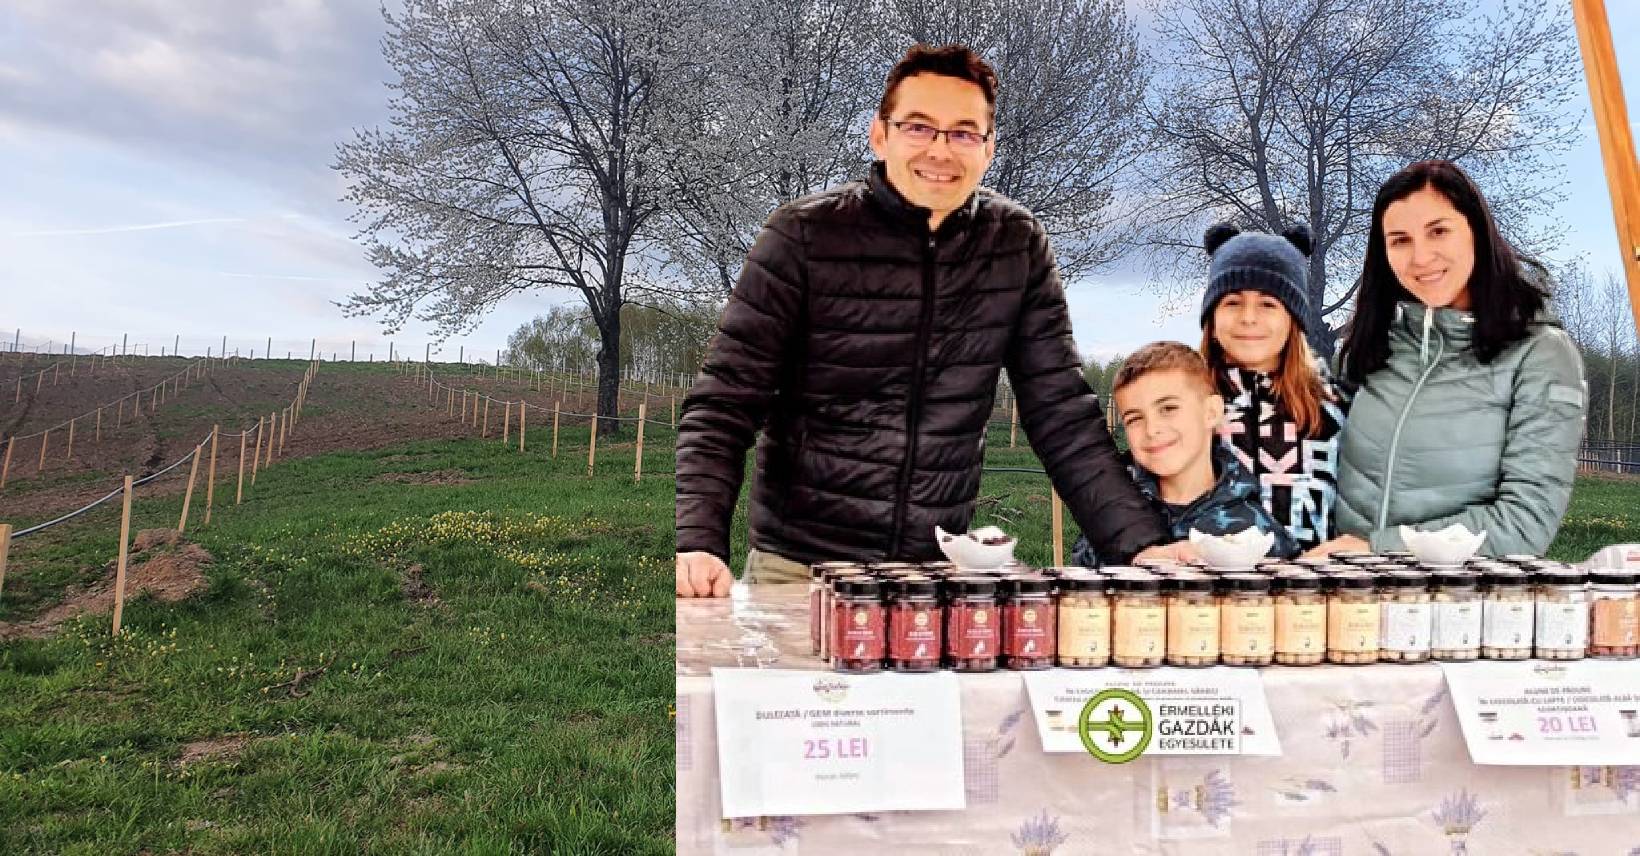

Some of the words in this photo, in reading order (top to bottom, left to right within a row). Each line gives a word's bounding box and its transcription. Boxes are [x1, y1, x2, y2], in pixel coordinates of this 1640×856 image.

[1537, 716, 1562, 733] 20
[1569, 715, 1598, 733] LEI
[804, 739, 830, 759] 25
[837, 737, 868, 759] LEI
